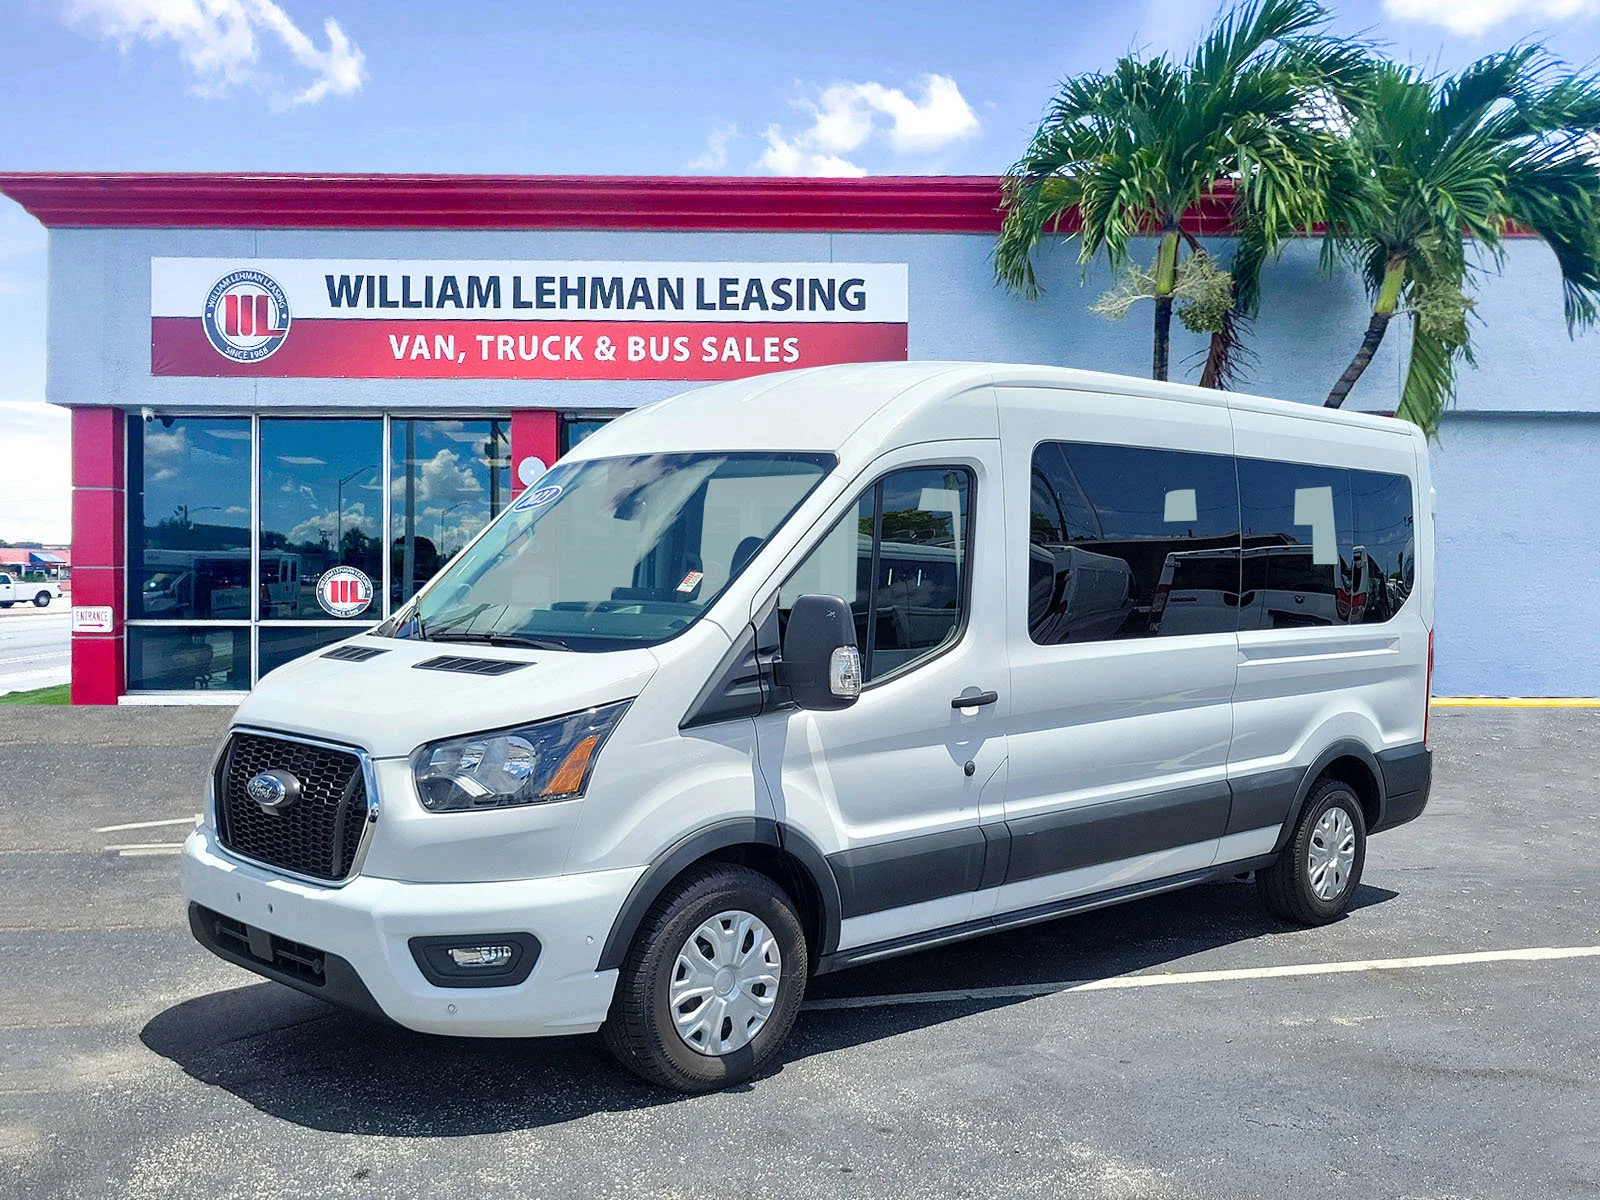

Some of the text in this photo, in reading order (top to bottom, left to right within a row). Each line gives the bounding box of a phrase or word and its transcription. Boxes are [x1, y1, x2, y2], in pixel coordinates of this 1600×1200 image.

[207, 272, 287, 309] WILLIAM LEHMAN LEASING
[325, 275, 866, 312] WILLIAM LEHMAN LEASING
[225, 346, 269, 359] SINCE 1968
[388, 335, 800, 364] VAN, TRUCK & BUS SALES
[76, 611, 107, 621] ENTRANCE
[251, 779, 272, 797] Ford
